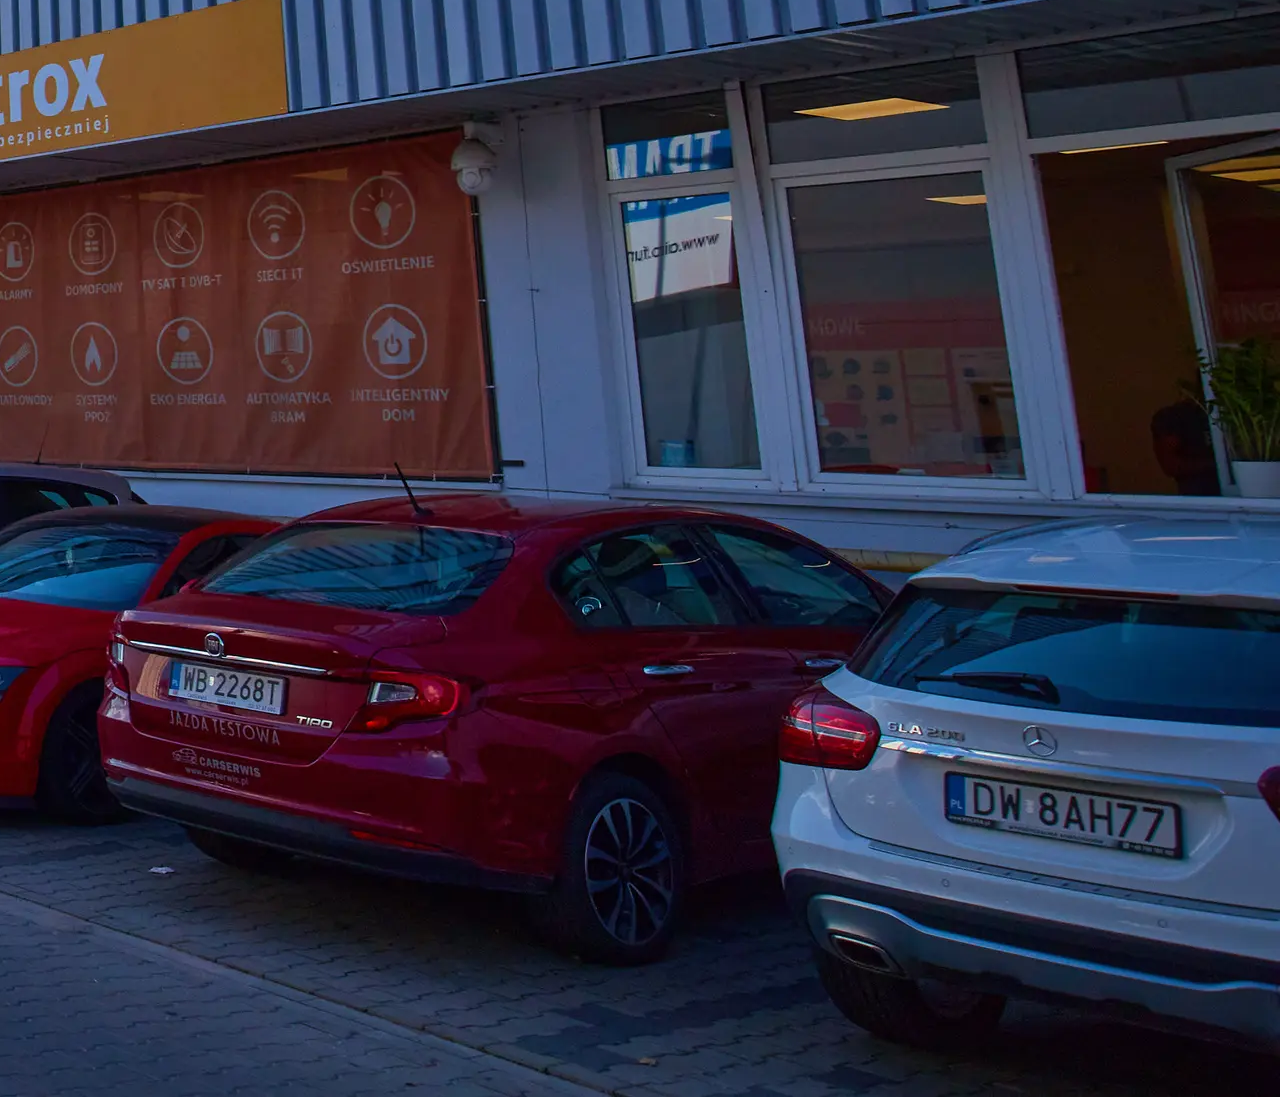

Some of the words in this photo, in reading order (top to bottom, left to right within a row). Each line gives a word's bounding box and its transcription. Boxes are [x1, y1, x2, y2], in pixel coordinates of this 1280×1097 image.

[141, 278, 157, 292] TV
[157, 277, 178, 291] SAT
[189, 273, 223, 289] DVB-T
[256, 268, 287, 283] SIECI
[290, 267, 304, 280] IT
[65, 283, 124, 296] DOMOFONY
[75, 395, 118, 406] SYSTEMY
[150, 393, 174, 405] EKO
[177, 393, 227, 405] ENERGIA
[246, 391, 332, 404] AUTOMATYKA
[350, 387, 450, 402] INTELIGENTNY
[271, 410, 306, 423] BRAM
[382, 408, 415, 422] DOM
[183, 666, 207, 693] WB
[214, 672, 280, 706] 2268T
[170, 710, 209, 732] JAZDA
[212, 718, 280, 745] TESTOWA
[296, 715, 333, 730] TIPO
[887, 721, 923, 736] GLA
[926, 726, 966, 743] 200
[199, 756, 261, 778] CARSERWIS
[973, 782, 1022, 822] DW
[1039, 793, 1165, 843] 8AH77
